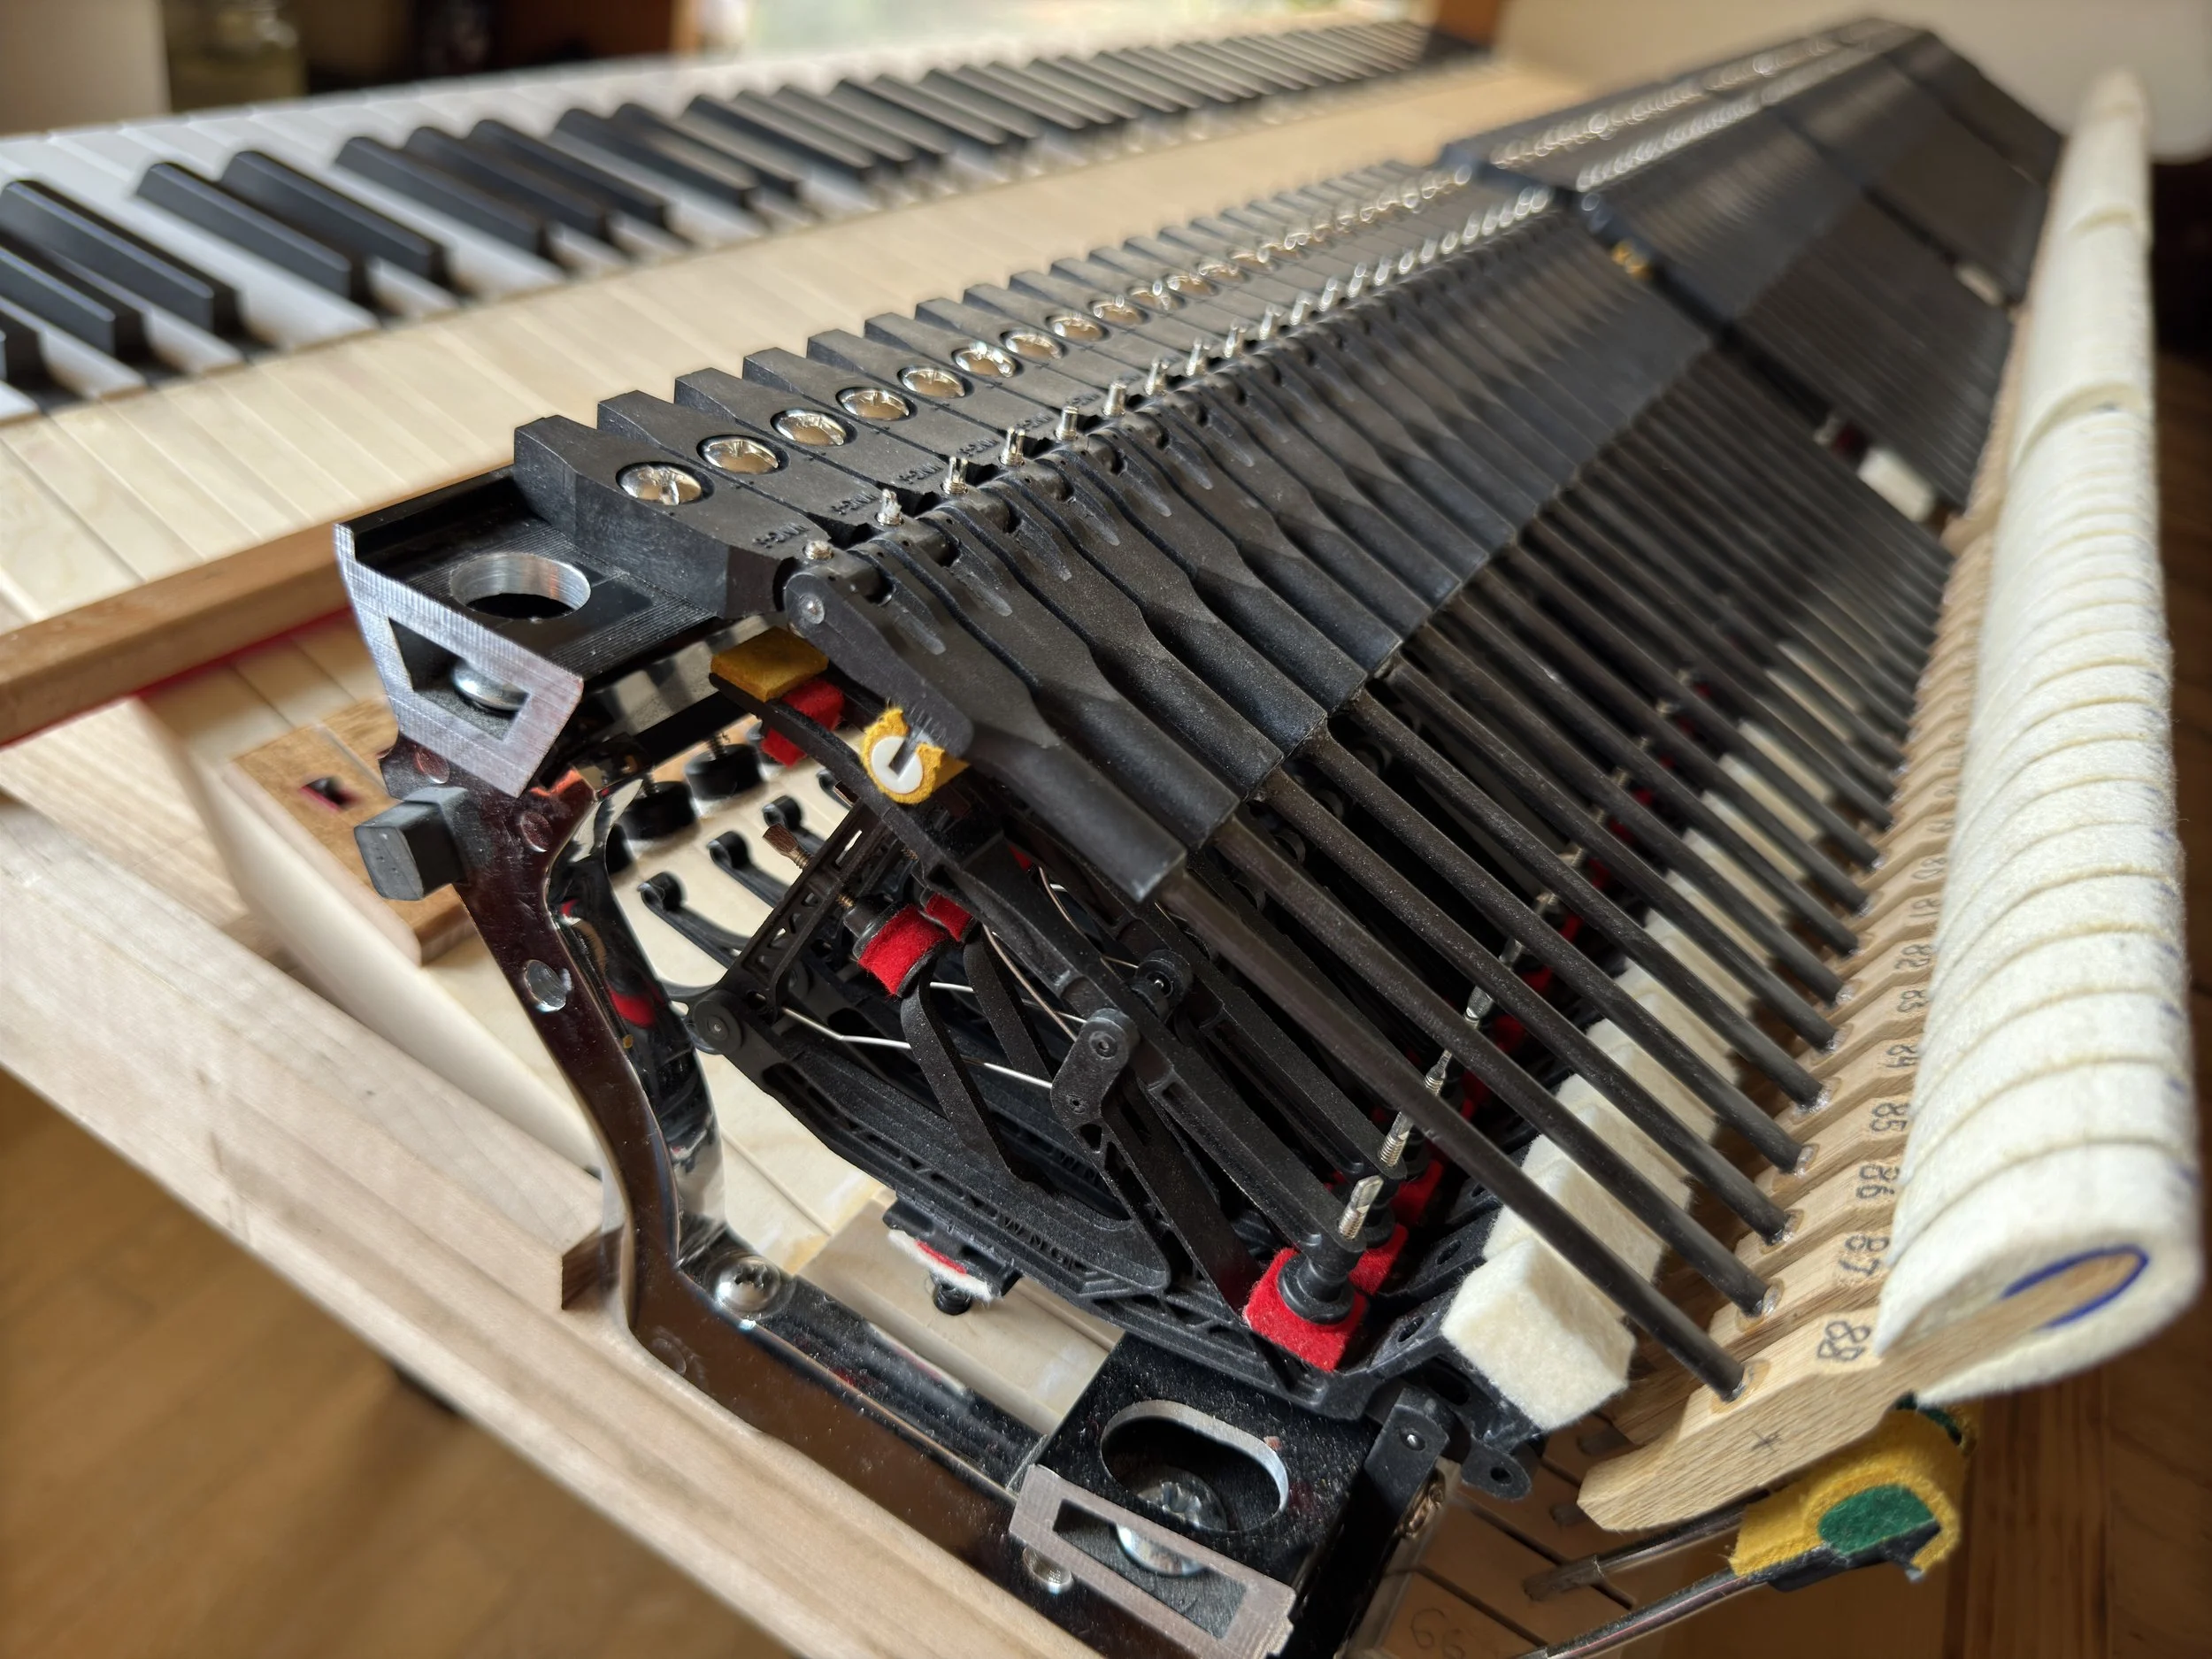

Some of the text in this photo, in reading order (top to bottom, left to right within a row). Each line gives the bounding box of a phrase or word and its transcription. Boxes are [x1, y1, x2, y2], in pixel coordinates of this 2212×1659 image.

[1894, 944, 1932, 970] 82
[1897, 988, 1927, 1013] 83
[1870, 1102, 1909, 1133] 85
[1856, 1164, 1901, 1199] 86
[1838, 1234, 1889, 1277] 87
[1817, 1320, 1871, 1362] 88
